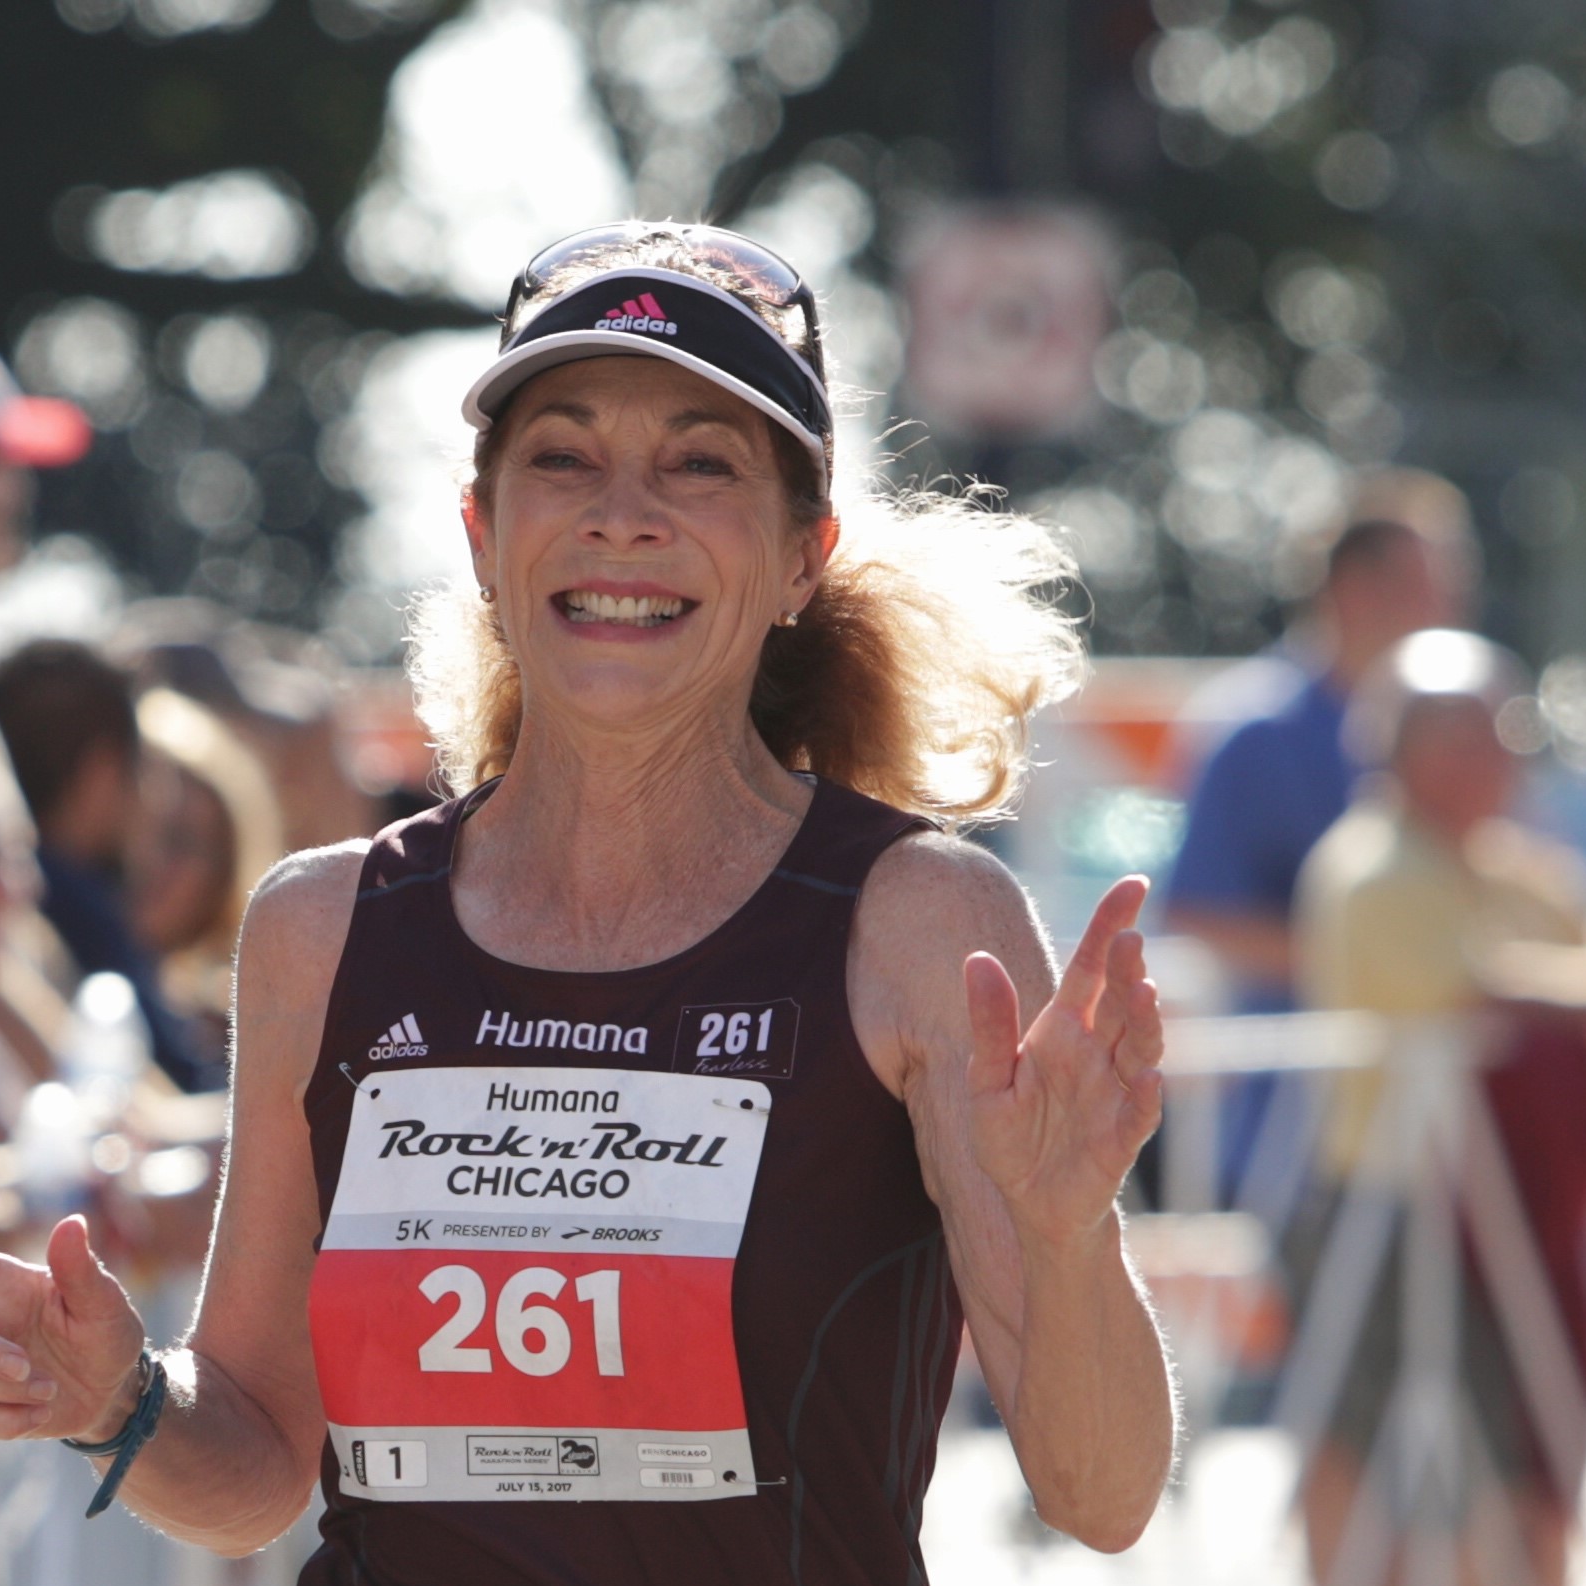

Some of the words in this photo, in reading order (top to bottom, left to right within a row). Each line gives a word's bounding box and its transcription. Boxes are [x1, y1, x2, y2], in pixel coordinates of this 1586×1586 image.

[595, 316, 677, 335] adidas
[475, 1009, 648, 1055] Humana
[696, 1008, 772, 1058] 261
[368, 1042, 429, 1061] adidas
[691, 1055, 770, 1075] Fearless
[486, 1082, 620, 1114] Humana
[378, 1119, 532, 1160] Rock
[589, 1121, 728, 1168] Roll
[446, 1165, 630, 1200] CHICAGO
[395, 1219, 433, 1242] 5K
[443, 1223, 528, 1239] PRESENTED
[531, 1225, 551, 1239] BY
[591, 1228, 662, 1242] BROOKS
[418, 1264, 625, 1377] 261
[389, 1446, 401, 1480] 1
[496, 1482, 525, 1492] JULY
[528, 1482, 544, 1493] 15,
[547, 1482, 572, 1492] 2017
